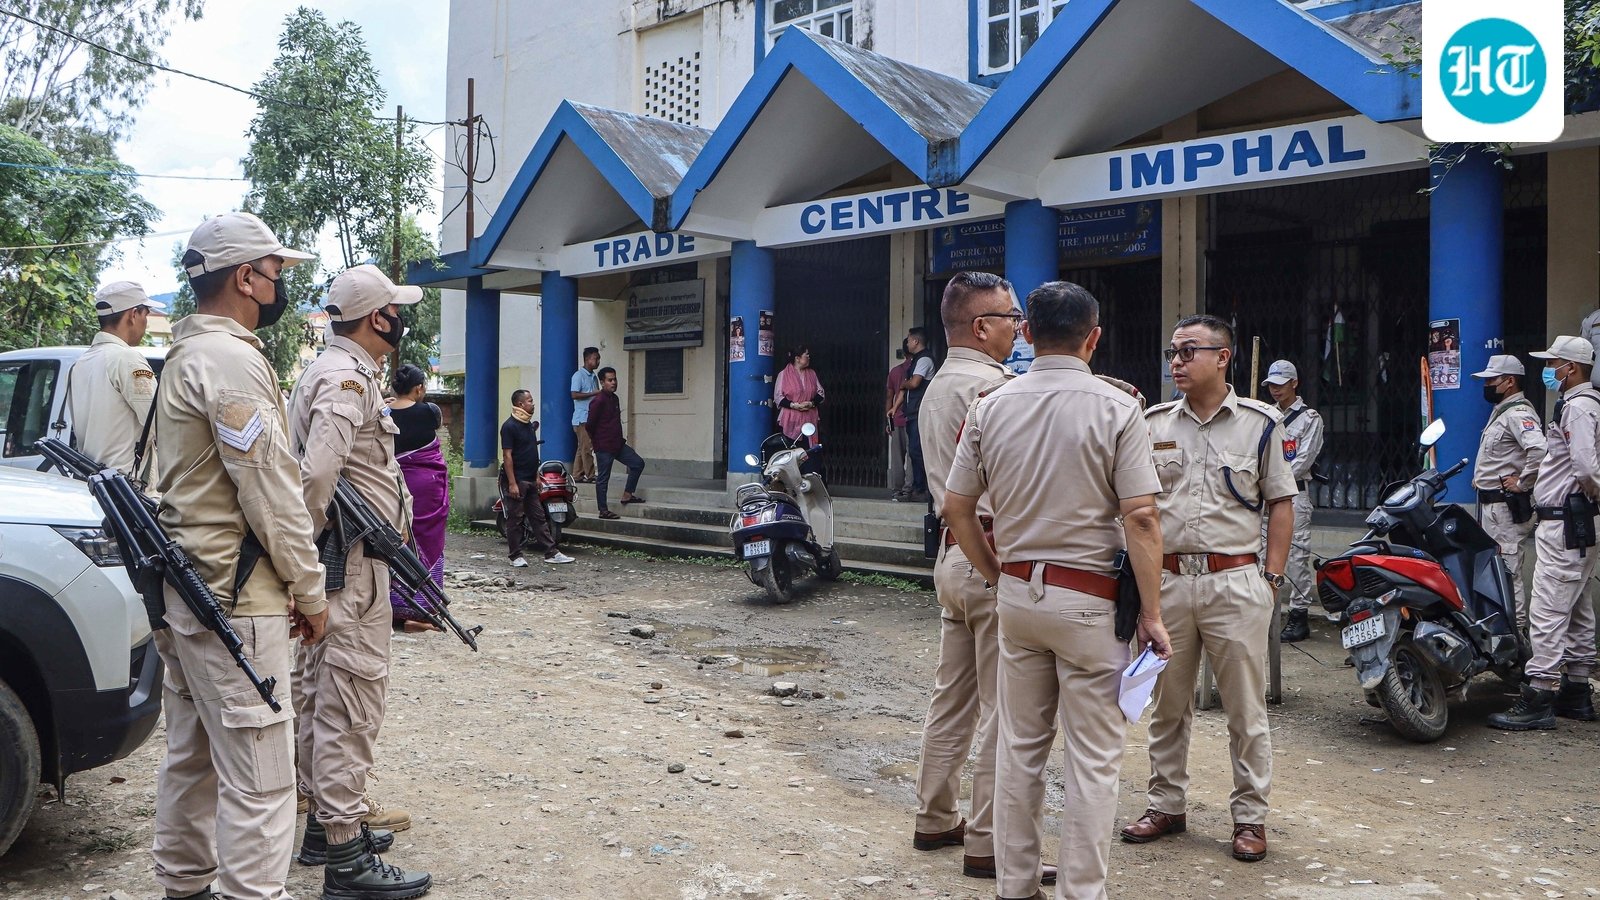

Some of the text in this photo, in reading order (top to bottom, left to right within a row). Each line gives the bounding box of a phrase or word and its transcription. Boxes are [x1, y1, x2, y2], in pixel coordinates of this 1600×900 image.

[593, 125, 1367, 267] TRADE CENTRE IMPHAL
[133, 370, 153, 378] POLICE
[342, 380, 364, 394] POLICE
